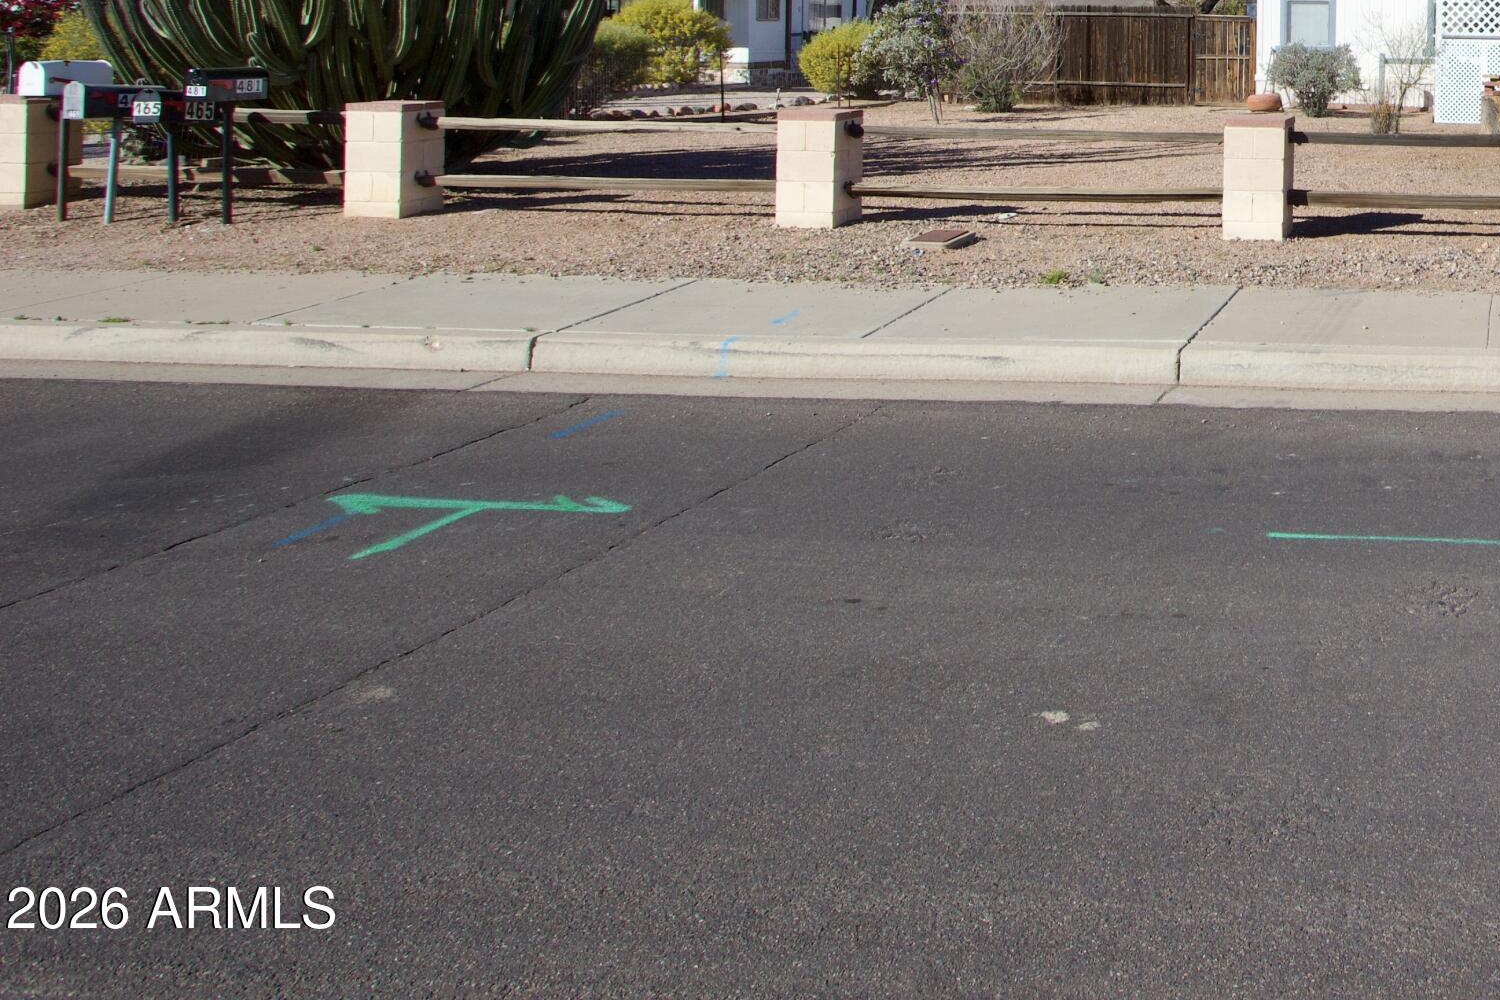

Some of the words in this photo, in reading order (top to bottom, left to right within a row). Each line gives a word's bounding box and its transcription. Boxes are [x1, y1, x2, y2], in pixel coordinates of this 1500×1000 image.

[187, 86, 204, 96] 481
[237, 80, 260, 92] 481
[187, 101, 213, 119] 465
